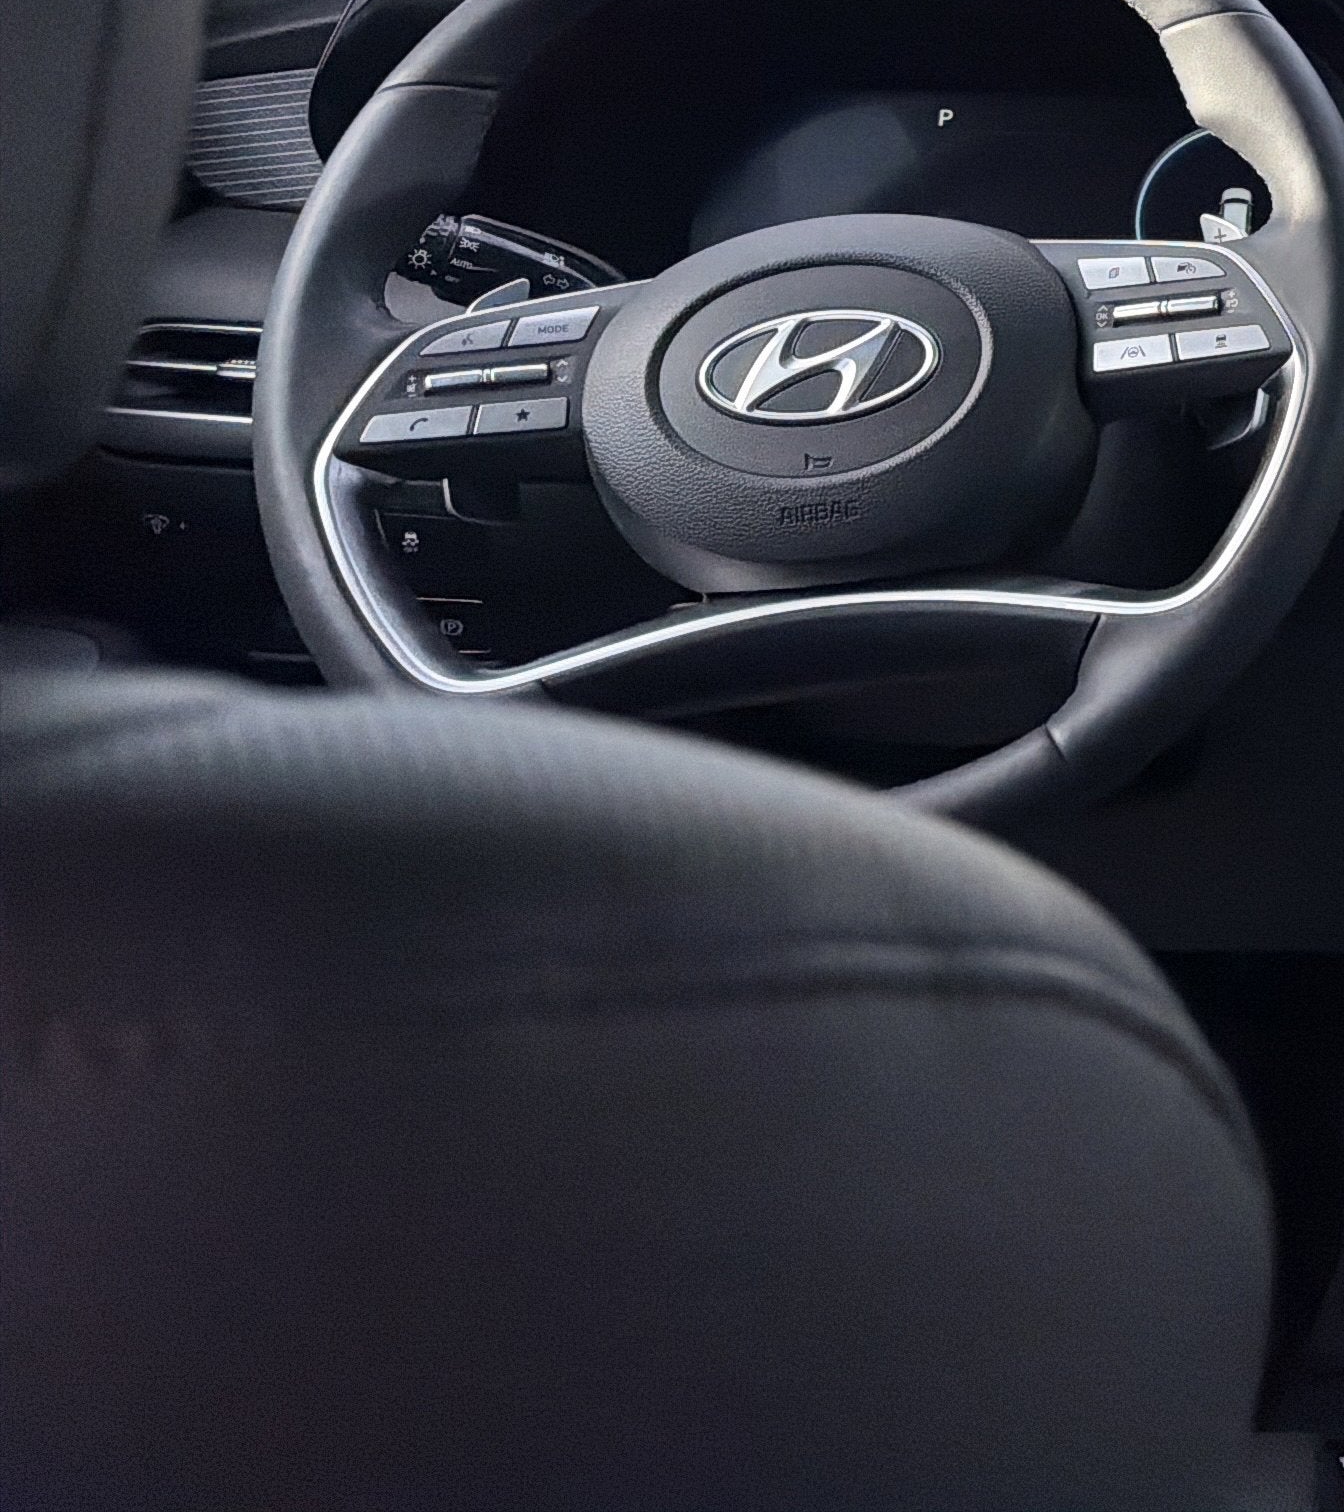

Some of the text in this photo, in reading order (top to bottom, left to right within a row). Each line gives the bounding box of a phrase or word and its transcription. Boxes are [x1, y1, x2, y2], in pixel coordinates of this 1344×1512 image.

[938, 108, 954, 127] P
[450, 257, 473, 270] AUTO
[537, 322, 570, 335] MODE
[778, 500, 862, 526] AIRBAG
